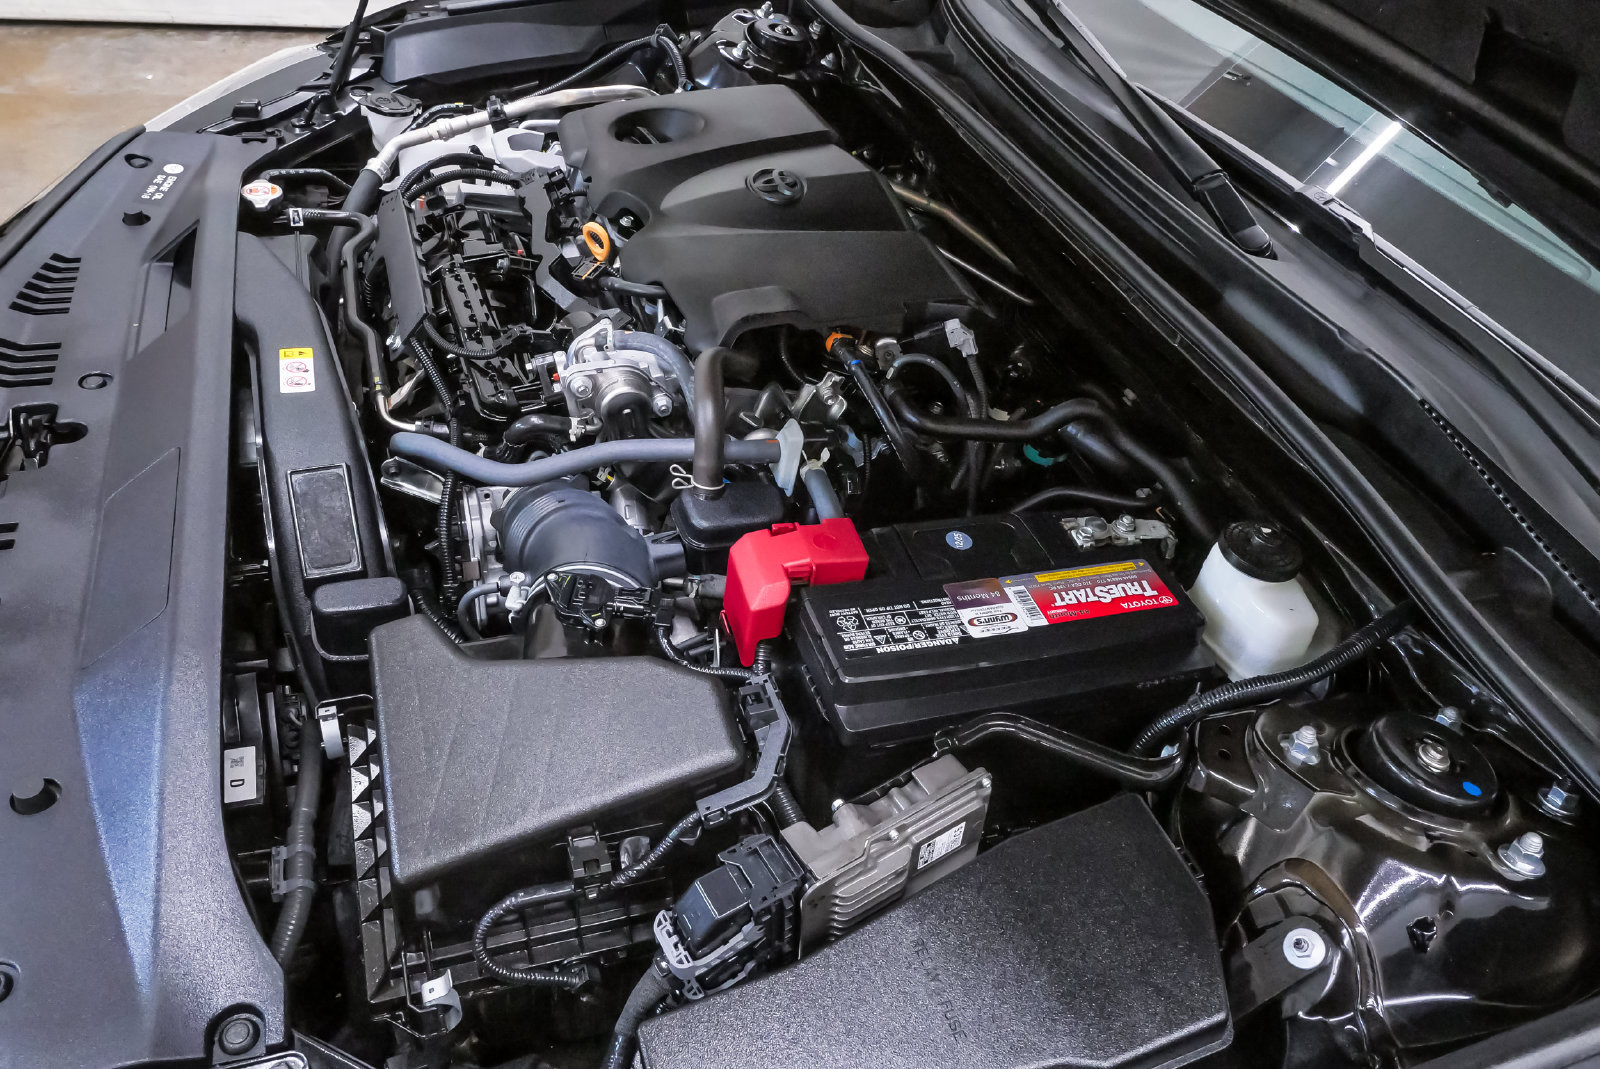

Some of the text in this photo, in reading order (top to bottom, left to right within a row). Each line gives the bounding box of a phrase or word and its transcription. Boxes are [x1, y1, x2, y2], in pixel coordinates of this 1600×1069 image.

[954, 532, 963, 548] 12/25
[957, 593, 989, 601] Months
[1120, 598, 1159, 609] TOYOTA
[876, 638, 953, 653] DANGER/POISON
[230, 779, 245, 787] D
[940, 1000, 967, 1042] FUSE
